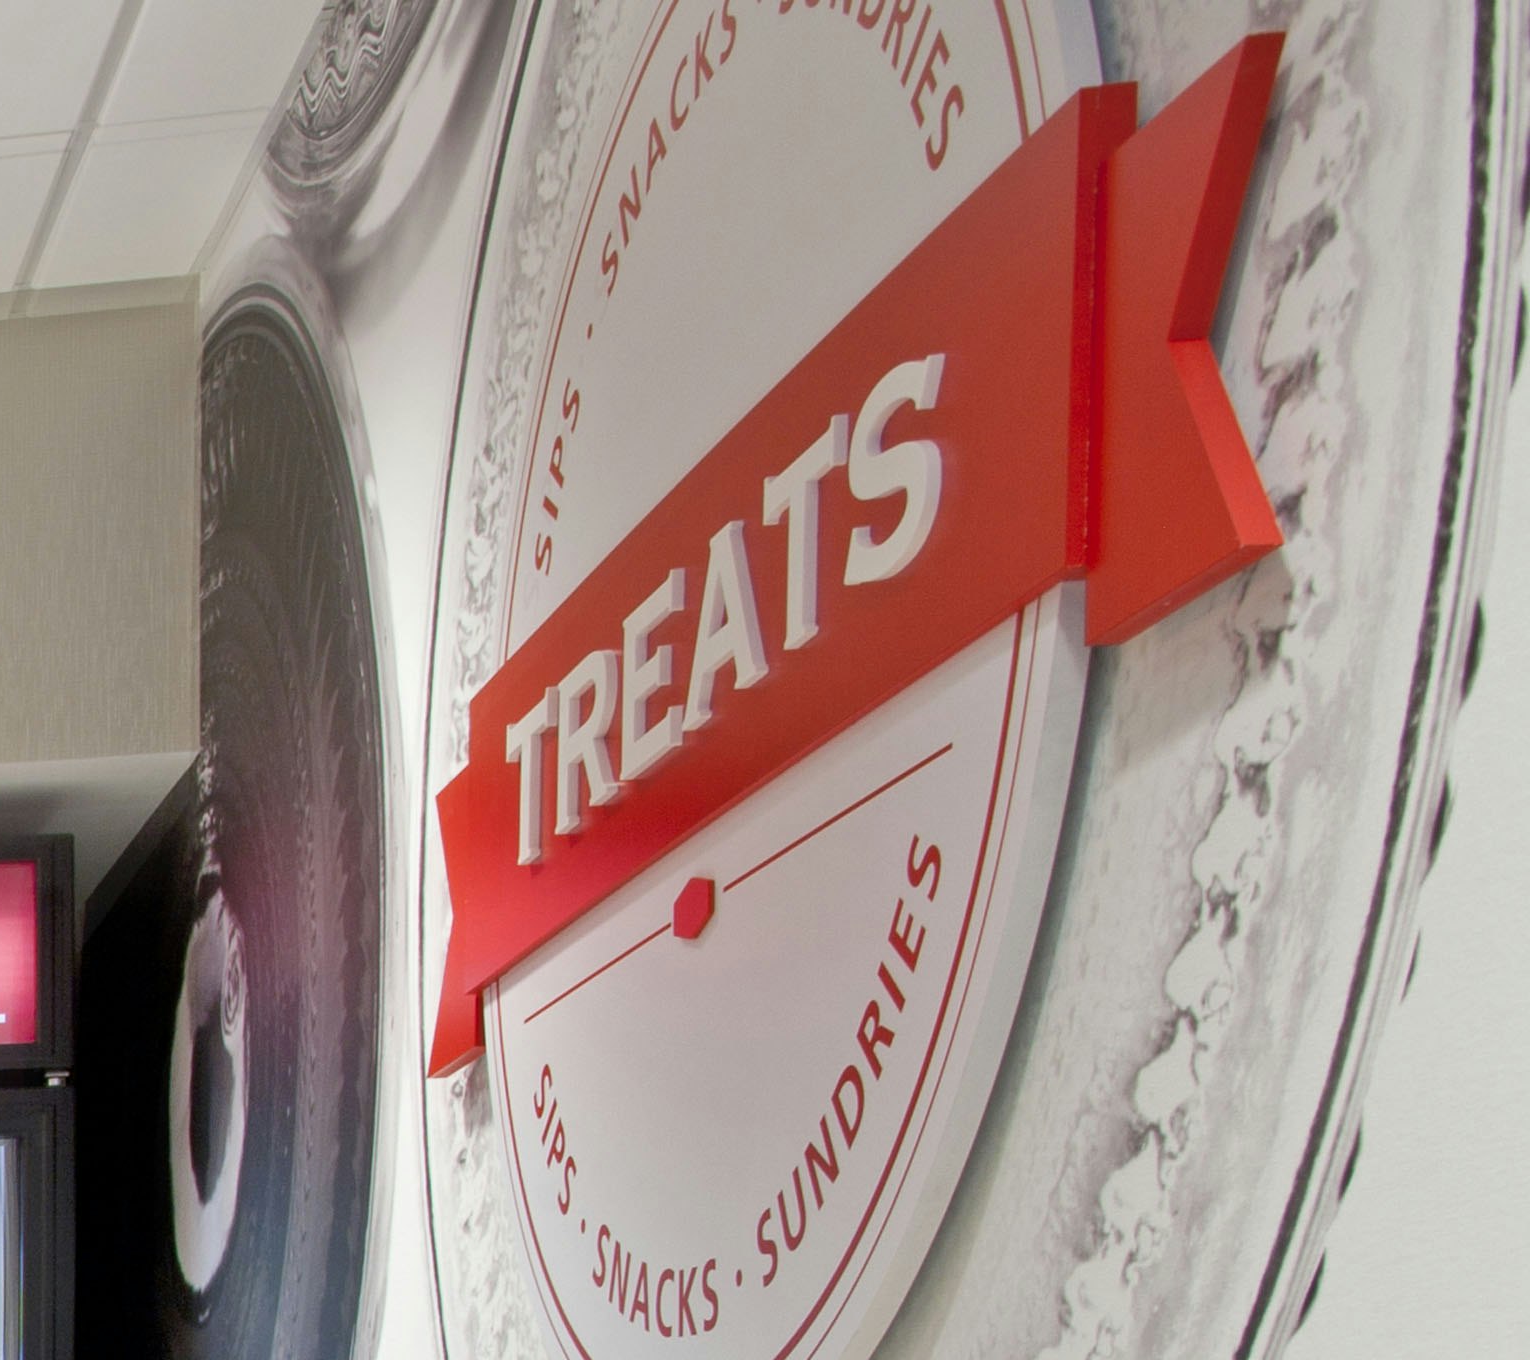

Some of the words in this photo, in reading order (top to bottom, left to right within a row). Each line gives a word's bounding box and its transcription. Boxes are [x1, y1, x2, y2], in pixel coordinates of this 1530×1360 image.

[601, 6, 738, 295] SNACKS
[503, 352, 949, 867] TREATS
[533, 377, 582, 577] SIPS
[533, 1061, 578, 1216] SIPS
[591, 1222, 720, 1339] SNACKS
[758, 832, 946, 1288] SUNDRIES
